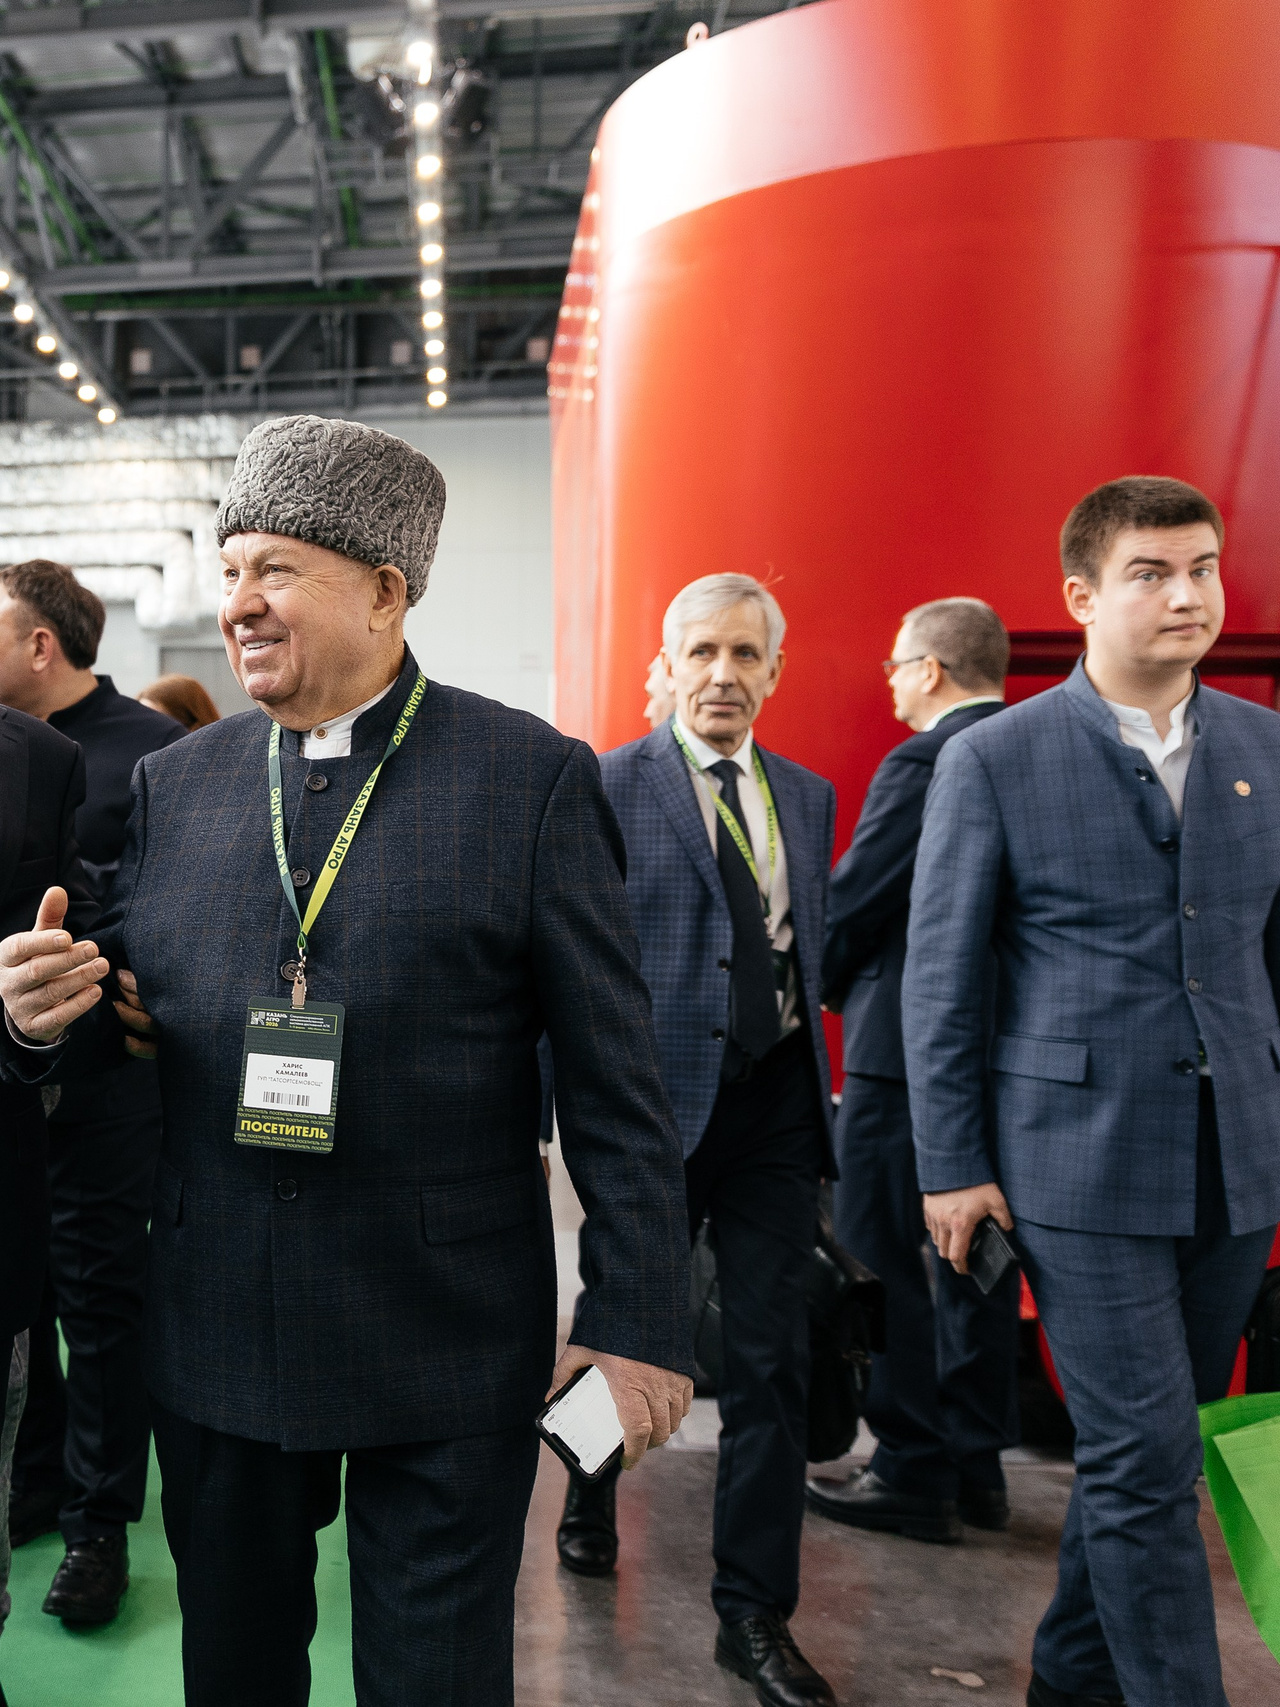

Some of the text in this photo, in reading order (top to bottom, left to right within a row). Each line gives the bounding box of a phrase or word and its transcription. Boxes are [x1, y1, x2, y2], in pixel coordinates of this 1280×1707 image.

[393, 678, 426, 746] КАЗАНЬ АГРО
[270, 787, 286, 867] КАЗАНЬ АГРО
[328, 784, 372, 870] КАЗАНЬ АГРО
[240, 1120, 328, 1139] ПОСЕТИТЕЛЬ
